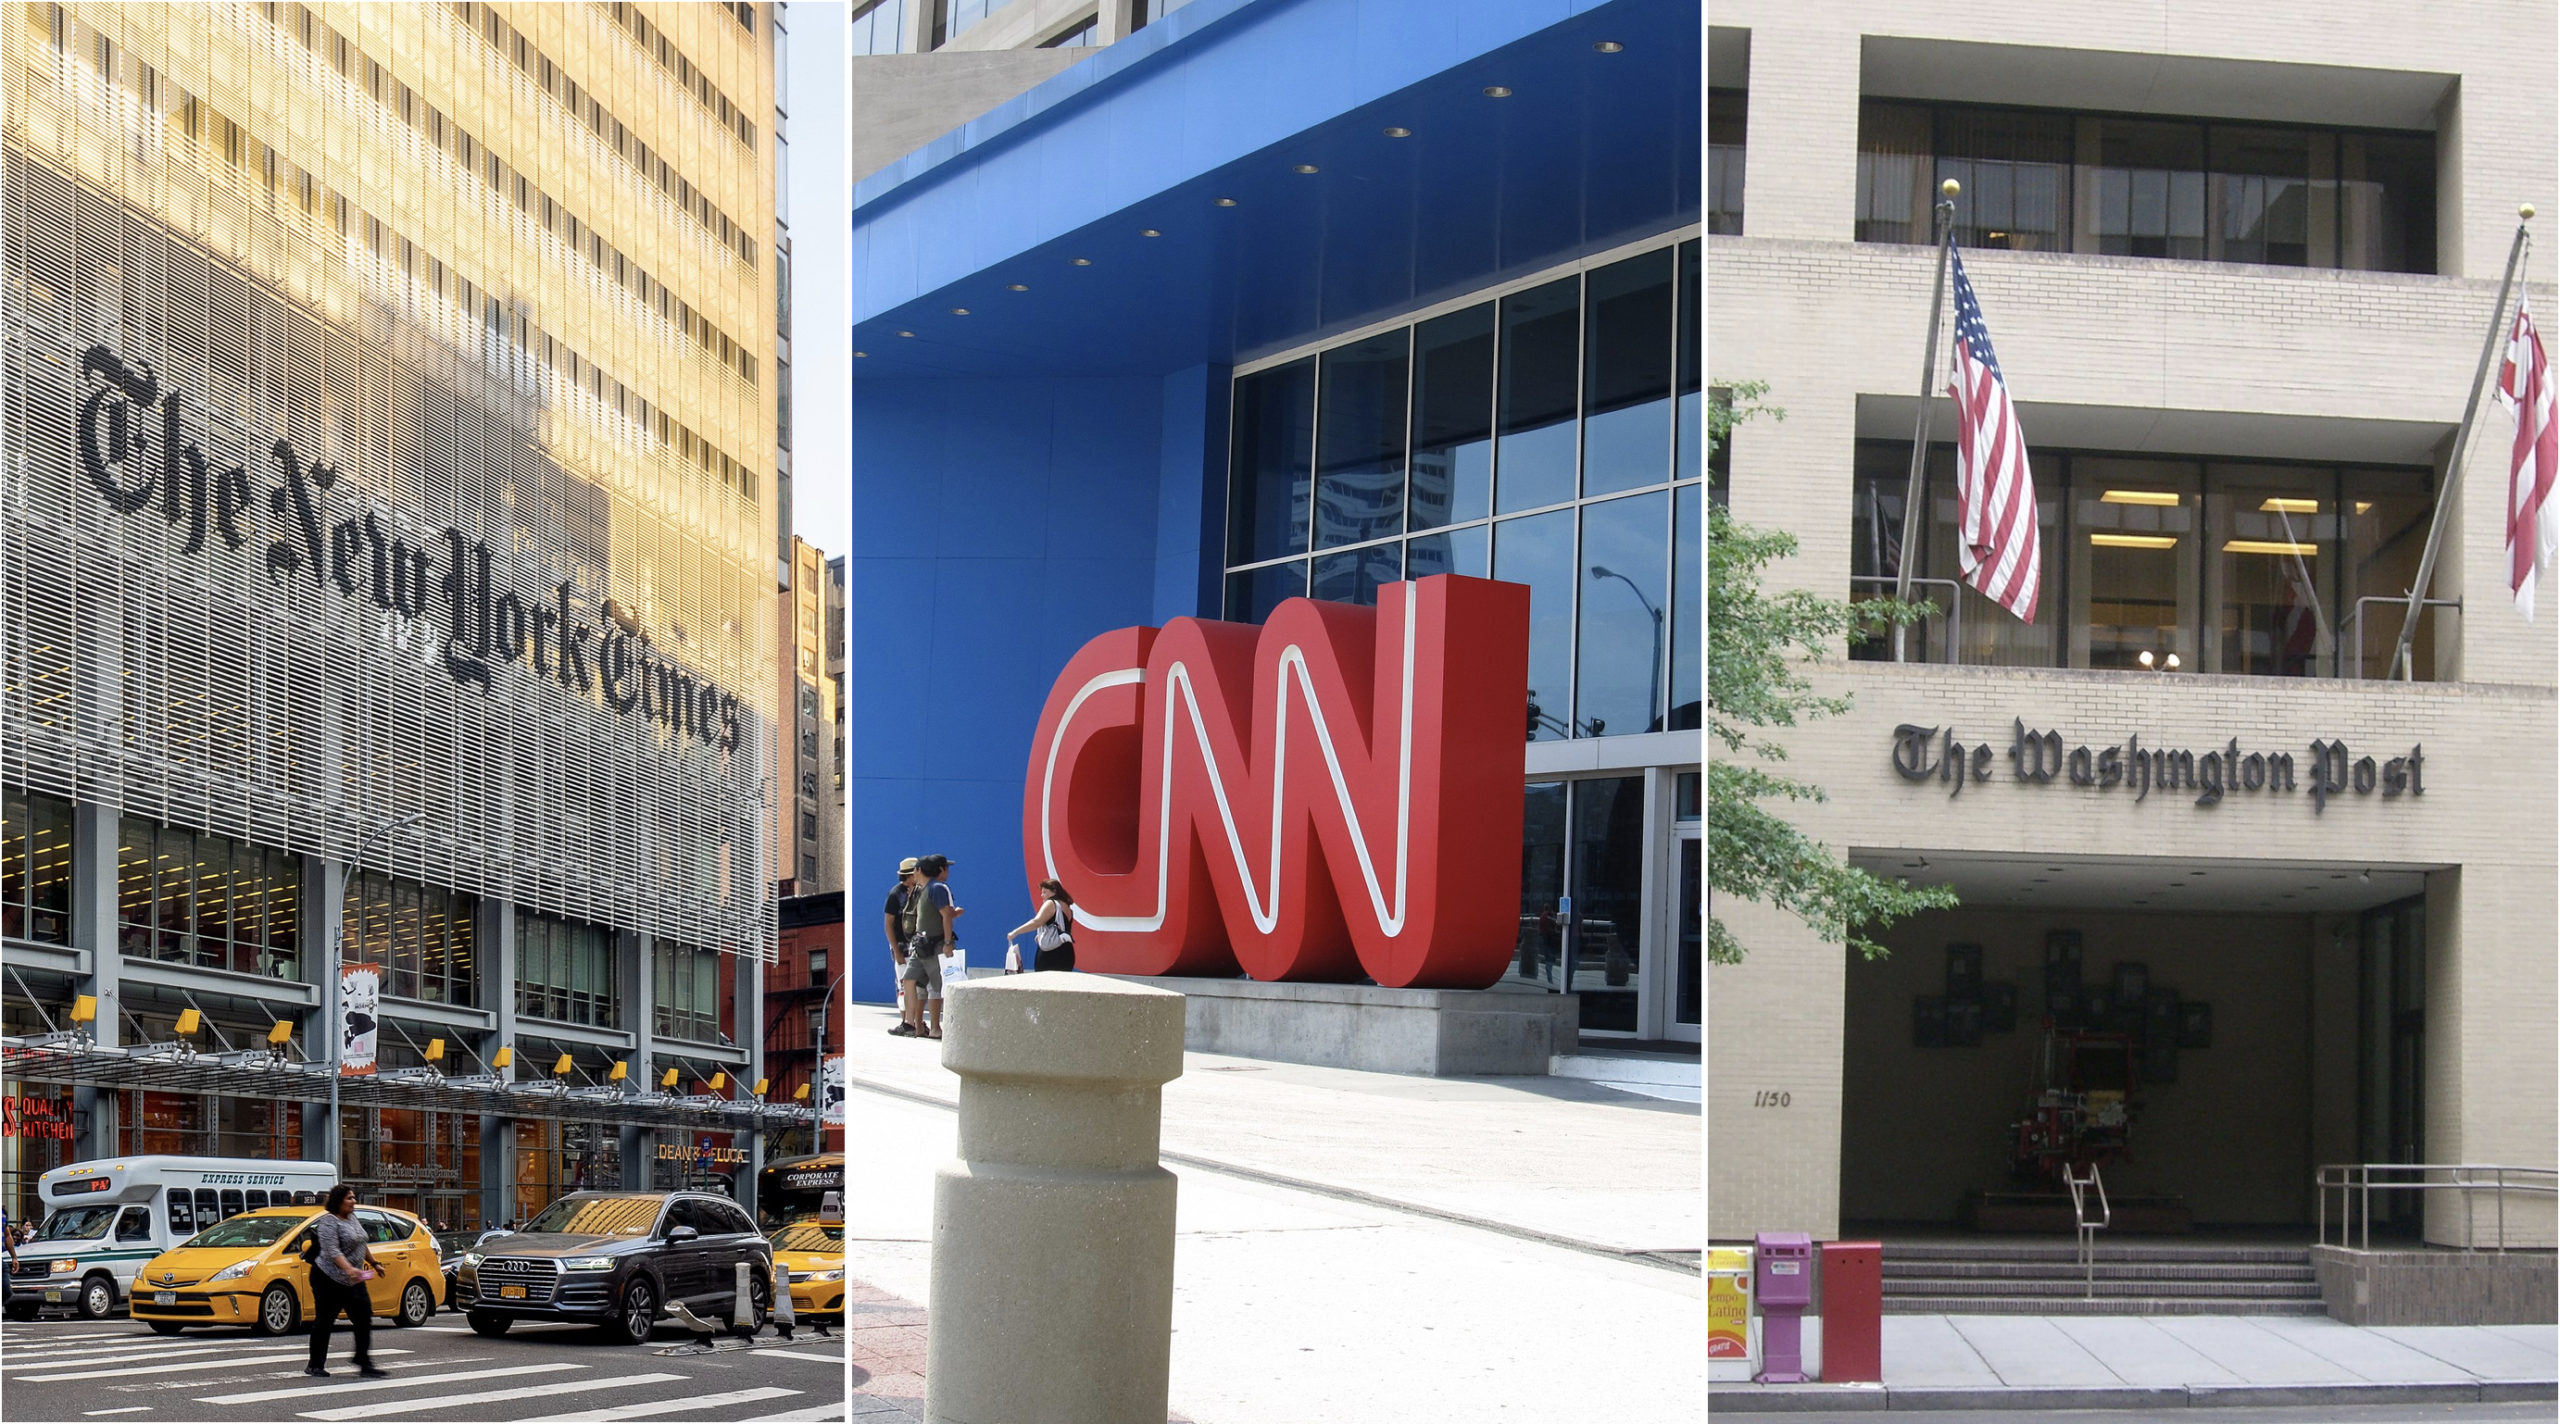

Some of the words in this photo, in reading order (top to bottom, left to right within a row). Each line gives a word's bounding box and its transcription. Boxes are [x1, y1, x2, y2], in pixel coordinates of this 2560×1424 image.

[79, 343, 254, 552] The
[266, 436, 434, 621] New
[441, 526, 590, 697] York
[599, 598, 741, 755] Times
[1892, 723, 1993, 798] The
[2008, 715, 2296, 807] Washington
[2307, 737, 2426, 815] Post
[1023, 574, 1530, 991] CNN
[22, 1097, 73, 1117] QUALIY
[1754, 1090, 1791, 1108] 1150
[22, 1121, 74, 1140] KITCHEN
[659, 1143, 690, 1161] DEAN
[703, 1147, 744, 1163] ELUCA
[201, 1173, 244, 1185] EXPRESS
[247, 1175, 285, 1186] SERVICE
[787, 1171, 840, 1182] CORPORATE
[796, 1178, 835, 1187] EXPRESS
[1708, 1294, 1738, 1305] empo
[1708, 1303, 1746, 1318] Latino
